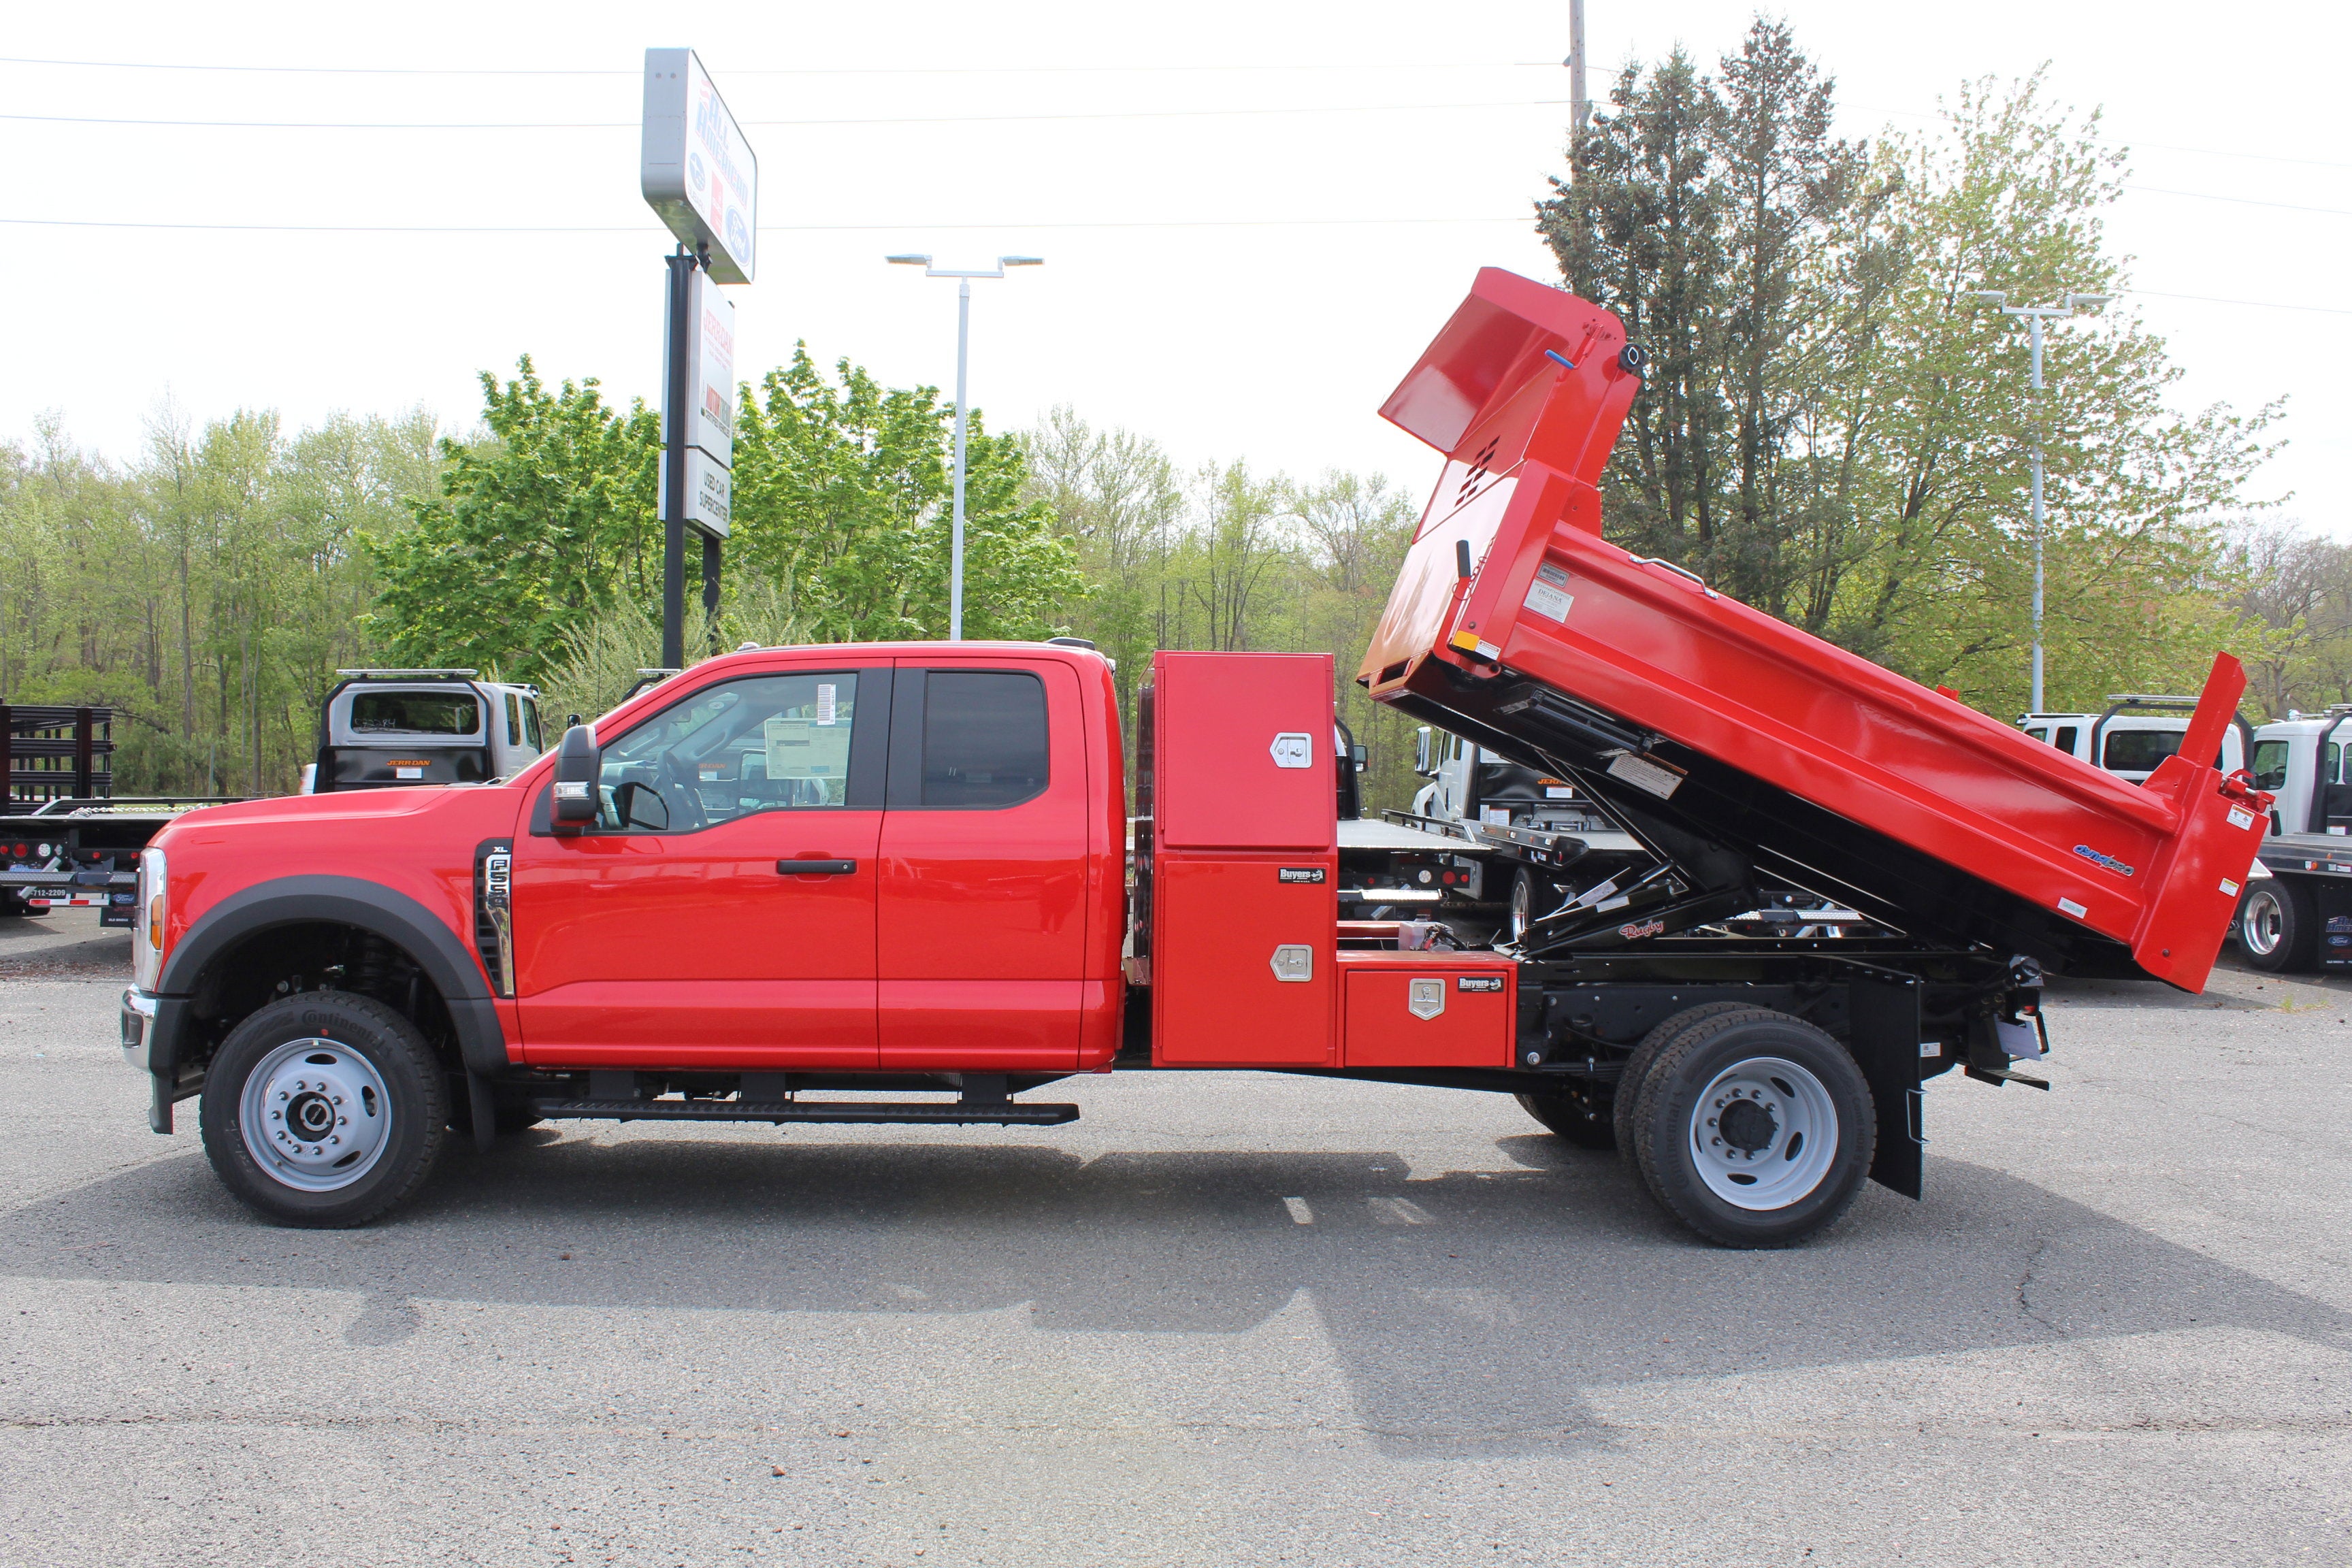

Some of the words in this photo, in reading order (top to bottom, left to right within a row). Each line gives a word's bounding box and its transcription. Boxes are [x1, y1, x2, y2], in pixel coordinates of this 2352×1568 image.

[709, 92, 730, 150] ALL
[695, 101, 749, 208] AMERICAN
[731, 212, 747, 257] Ford
[704, 470, 715, 491] USED
[716, 479, 725, 499] CAR
[700, 491, 728, 523] SUPERCENTER
[1538, 589, 1563, 604] DEJANA
[1279, 868, 1311, 880] Buyers
[1619, 919, 1664, 939] Rugby
[1459, 978, 1489, 988] Buyers
[301, 1009, 385, 1049] Continental
[1665, 1102, 1689, 1188] Continental
